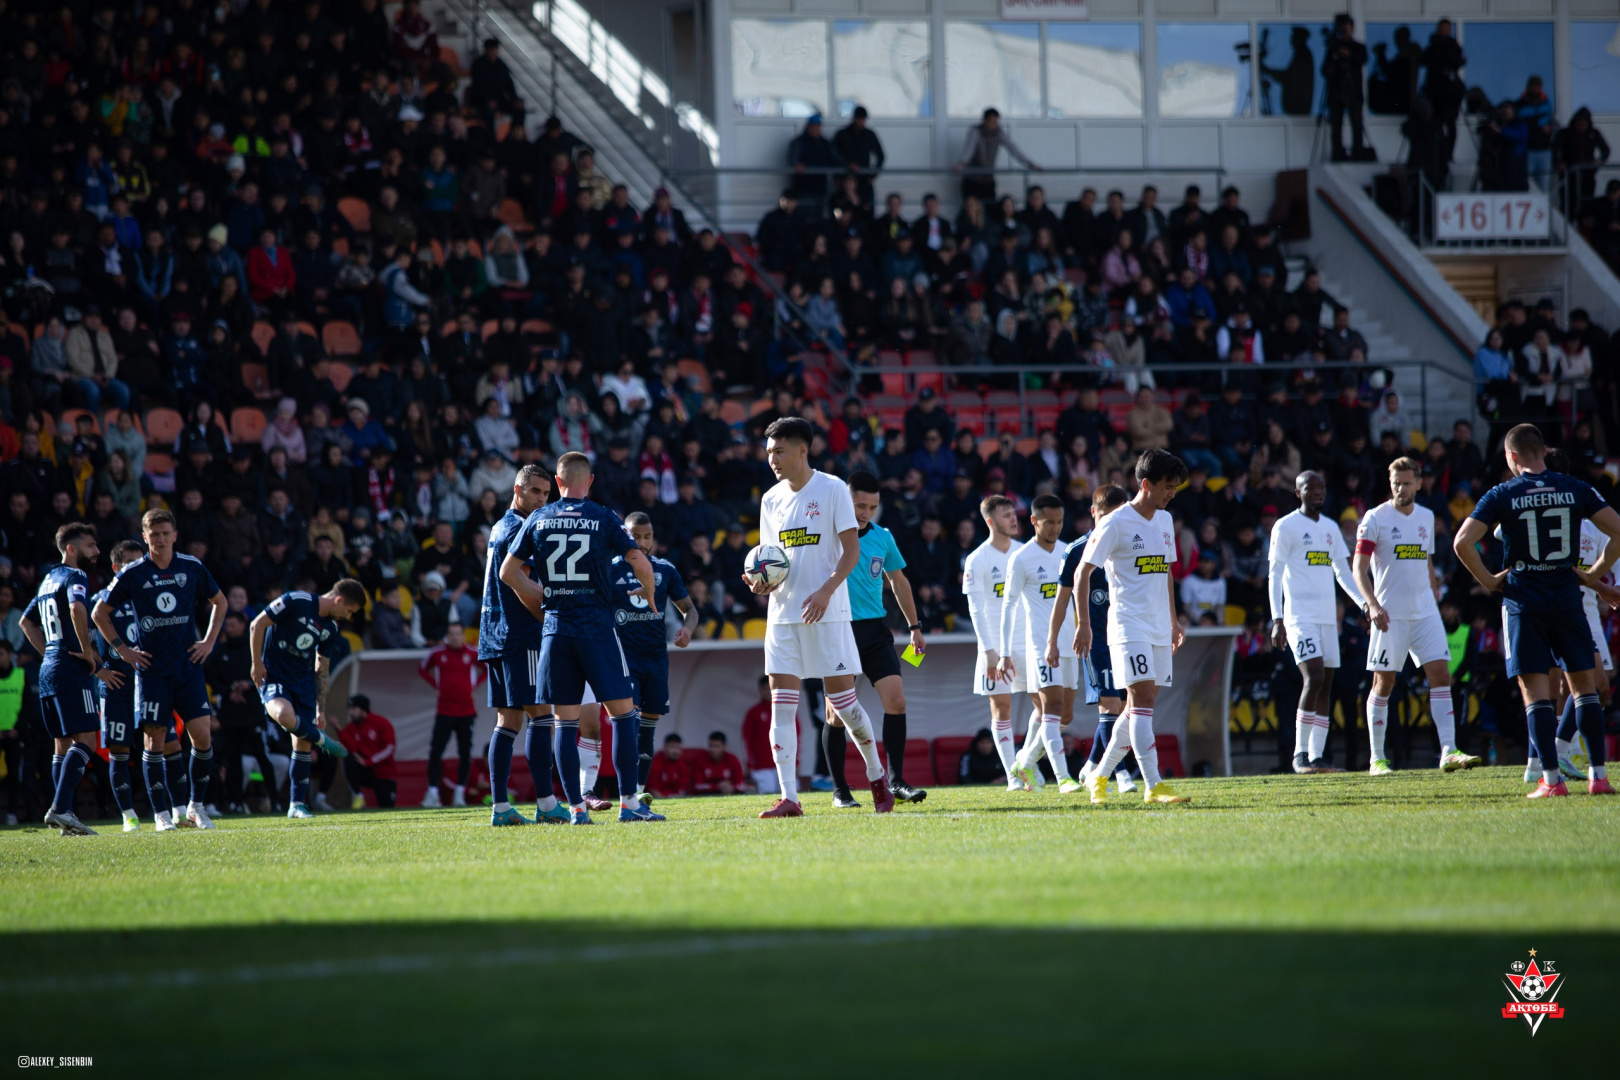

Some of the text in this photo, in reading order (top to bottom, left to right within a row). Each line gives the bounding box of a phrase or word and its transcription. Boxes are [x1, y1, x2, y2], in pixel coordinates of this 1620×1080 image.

[1453, 201, 1532, 231] 16 17
[1511, 492, 1576, 510] KIREENKO
[536, 517, 599, 532] BARANOVSKYI
[780, 528, 806, 541] PARI
[1518, 506, 1571, 562] 13
[784, 536, 819, 548] MATCH
[545, 533, 591, 582] 22
[38, 598, 64, 643] 18
[1297, 637, 1317, 658] 25
[1129, 653, 1149, 676] 18
[1369, 649, 1390, 668] 44
[1039, 665, 1053, 683] 31
[142, 701, 160, 721] 14
[109, 721, 126, 742] 19
